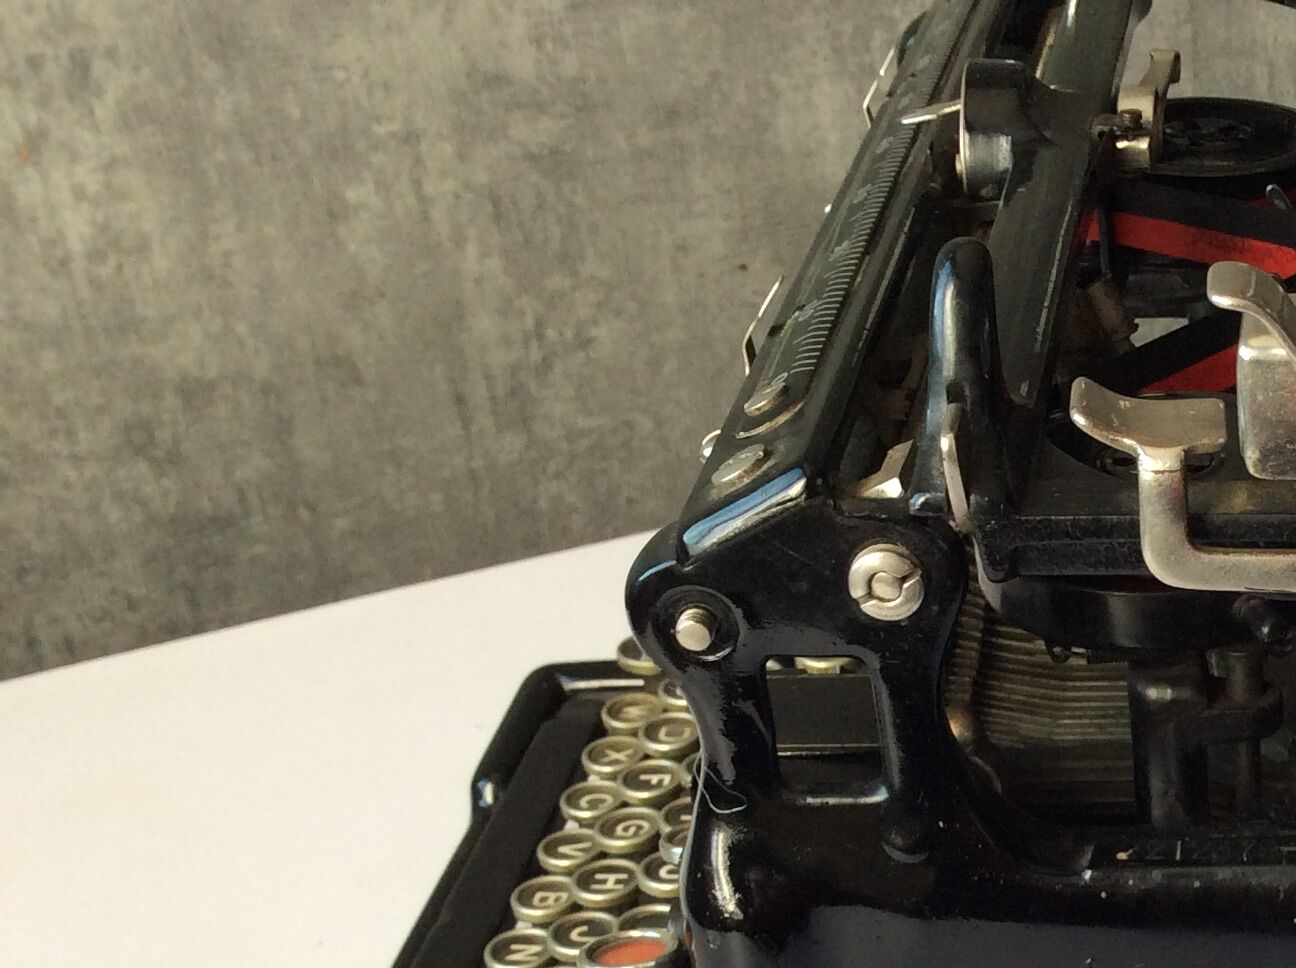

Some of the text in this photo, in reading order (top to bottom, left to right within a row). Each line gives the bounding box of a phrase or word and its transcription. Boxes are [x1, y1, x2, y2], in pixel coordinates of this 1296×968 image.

[603, 748, 632, 763] X
[639, 773, 673, 787] F
[578, 793, 614, 811] C
[615, 819, 650, 838] G
[557, 840, 593, 857] V
[590, 872, 628, 891] H
[531, 890, 570, 908] B
[568, 924, 590, 941] J
[502, 944, 545, 962] N
